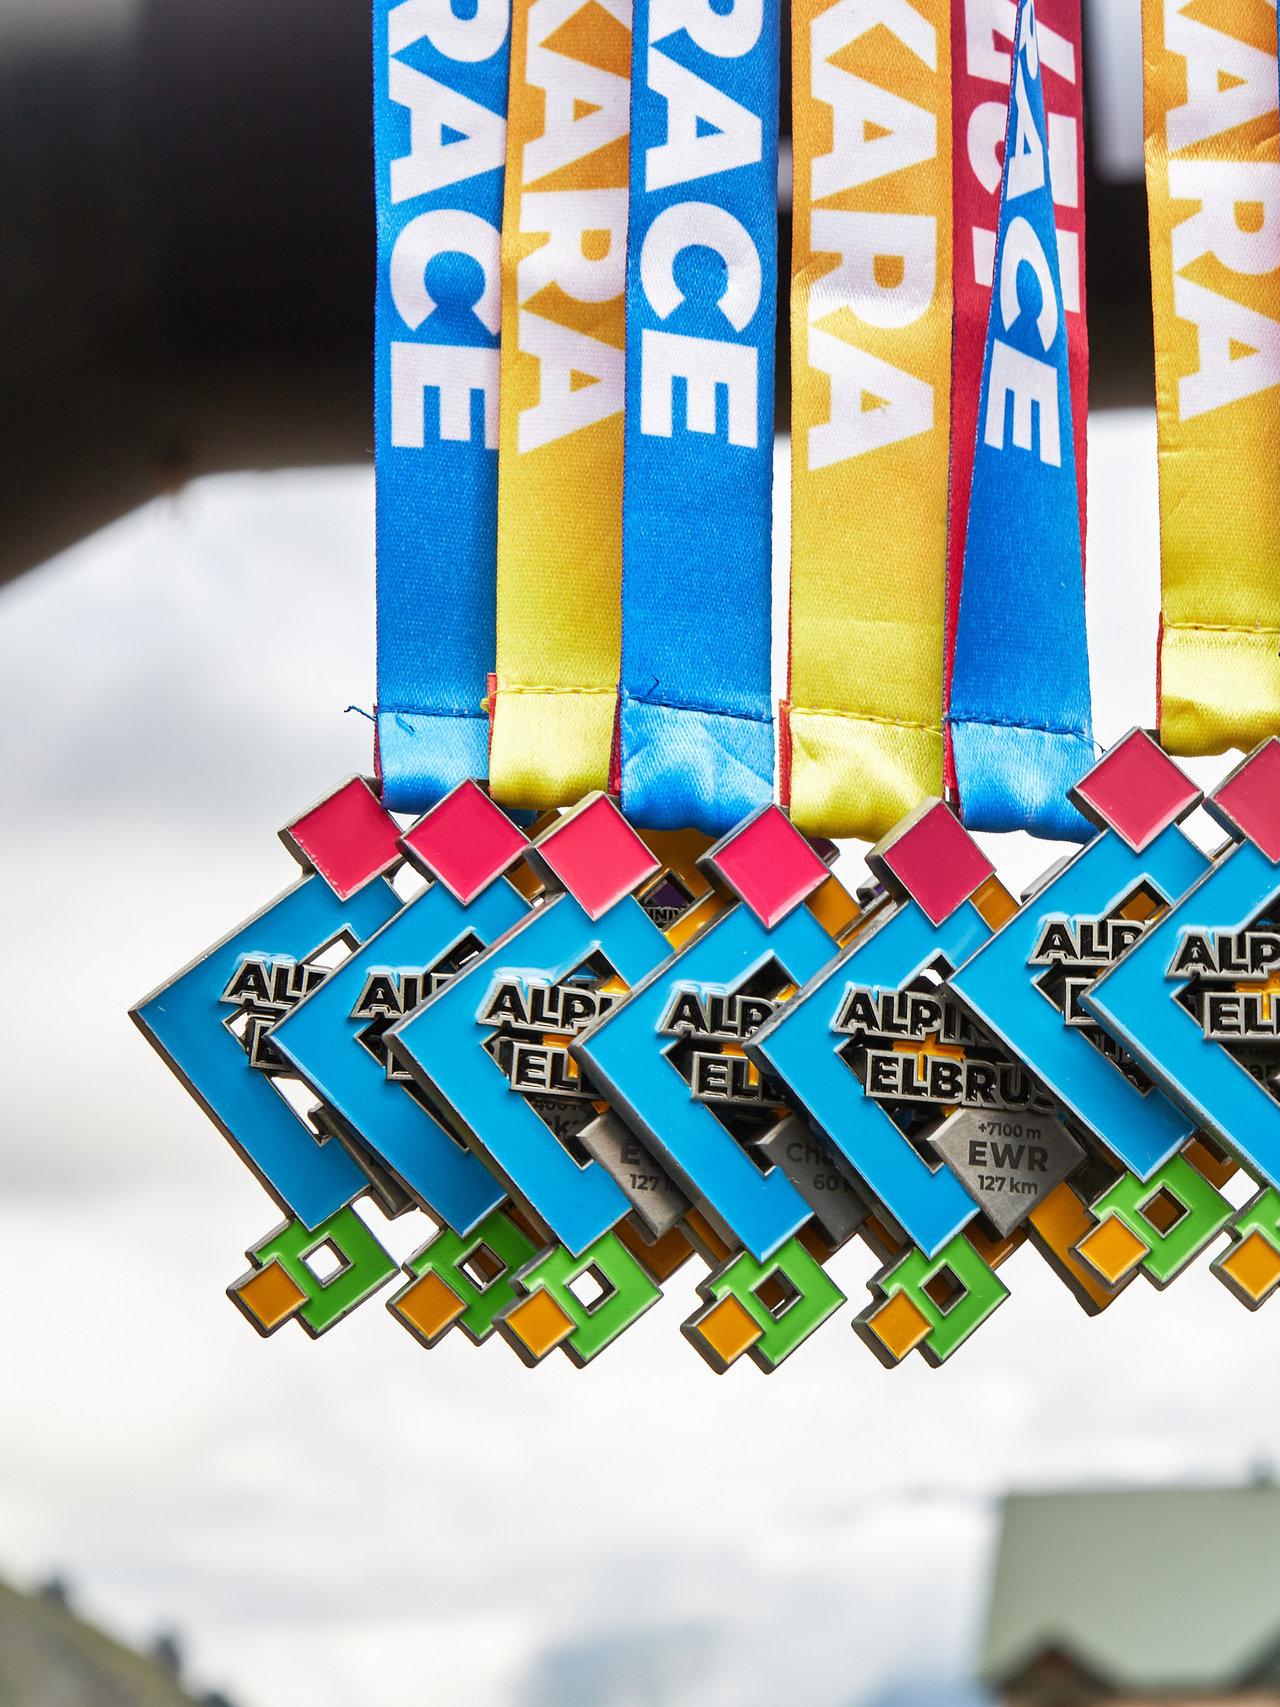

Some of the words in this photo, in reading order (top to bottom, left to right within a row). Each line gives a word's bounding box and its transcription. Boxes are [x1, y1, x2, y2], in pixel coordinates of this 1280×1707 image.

[1028, 919, 1151, 966] ALP
[659, 989, 780, 1042] ALP
[510, 1041, 604, 1099] EL
[691, 1051, 785, 1107] EL
[978, 1122, 1022, 1138] +7100
[1026, 1126, 1041, 1140] m
[969, 1140, 1048, 1173] EWR
[629, 1173, 660, 1192] 127
[812, 1174, 839, 1192] 60
[977, 1175, 1008, 1192] 127
[1010, 1177, 1039, 1195] km
